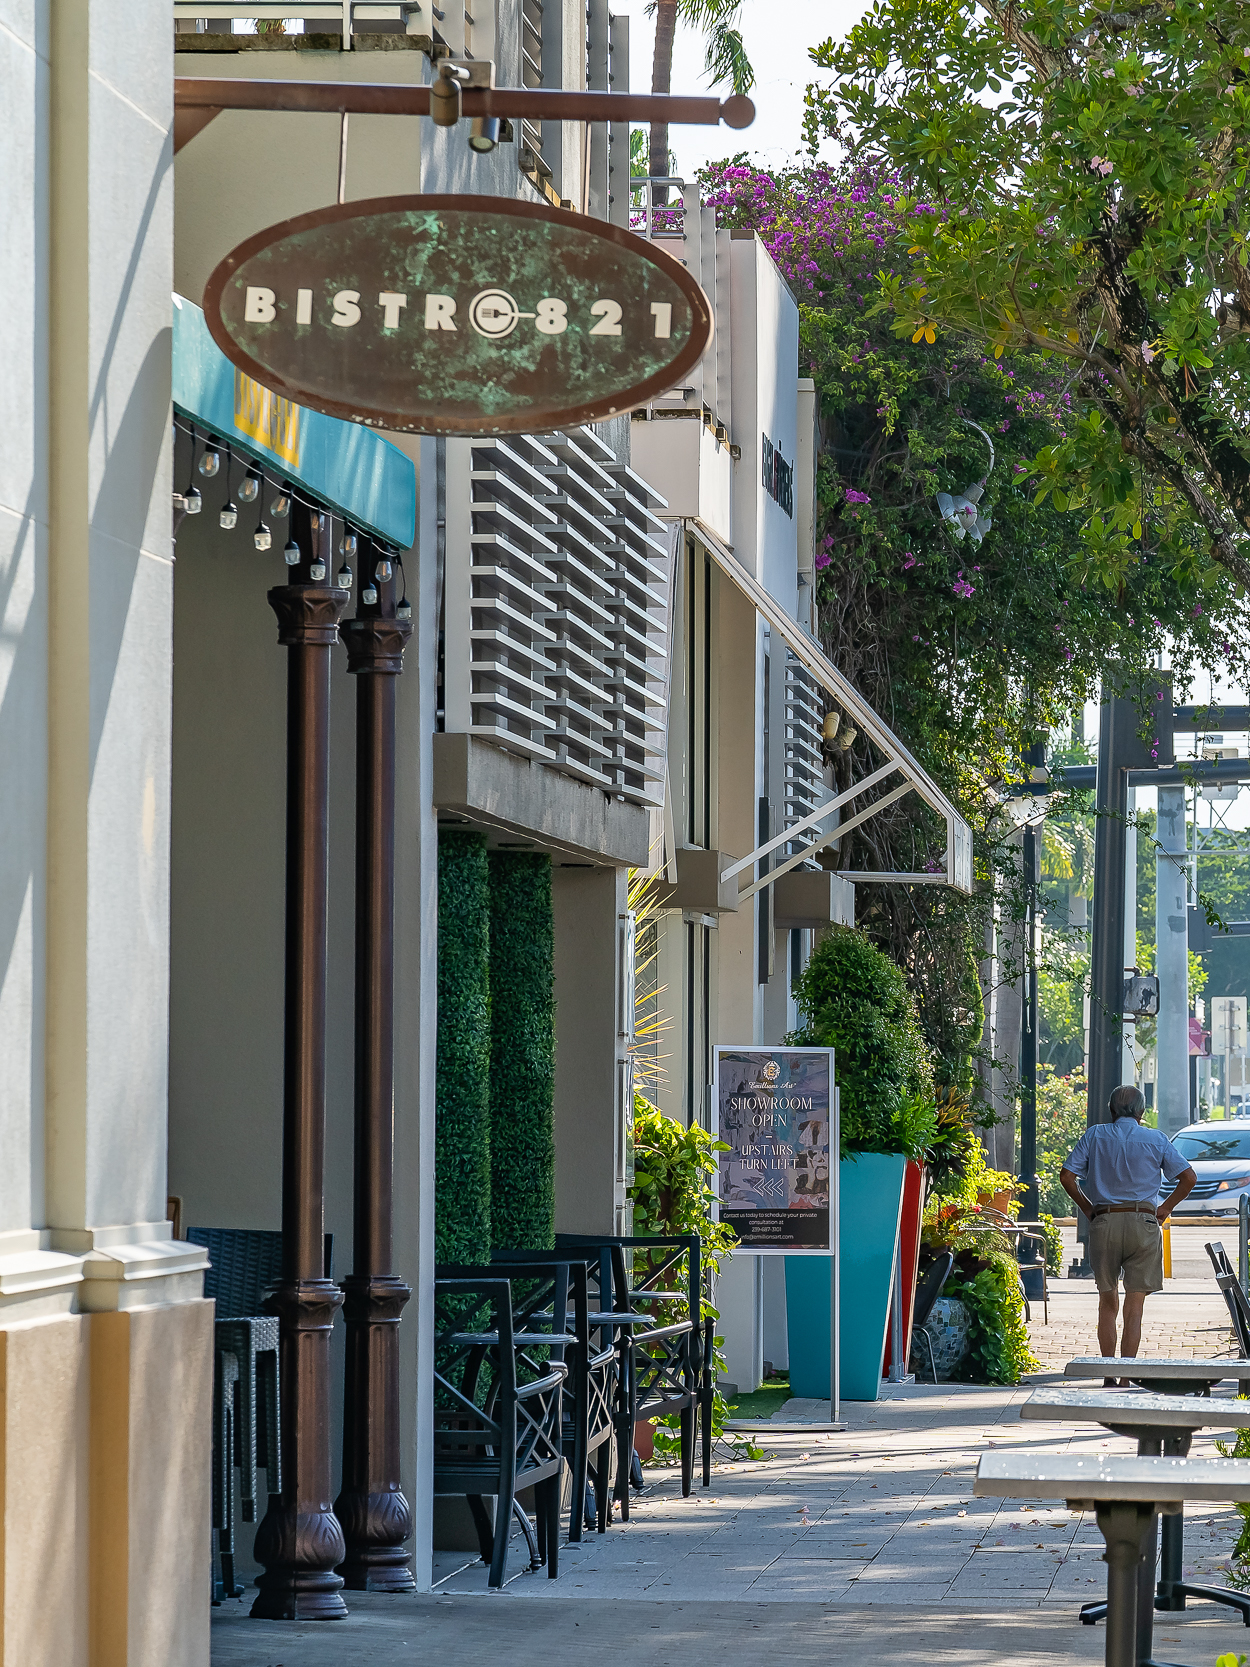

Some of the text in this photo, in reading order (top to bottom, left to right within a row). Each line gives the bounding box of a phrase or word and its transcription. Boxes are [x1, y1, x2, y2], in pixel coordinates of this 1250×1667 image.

[730, 1096, 813, 1110] SHOWROOM
[751, 1114, 787, 1127] OPEN
[741, 1144, 794, 1156] UPSTAIRS
[739, 1158, 800, 1170] TURN LEFT
